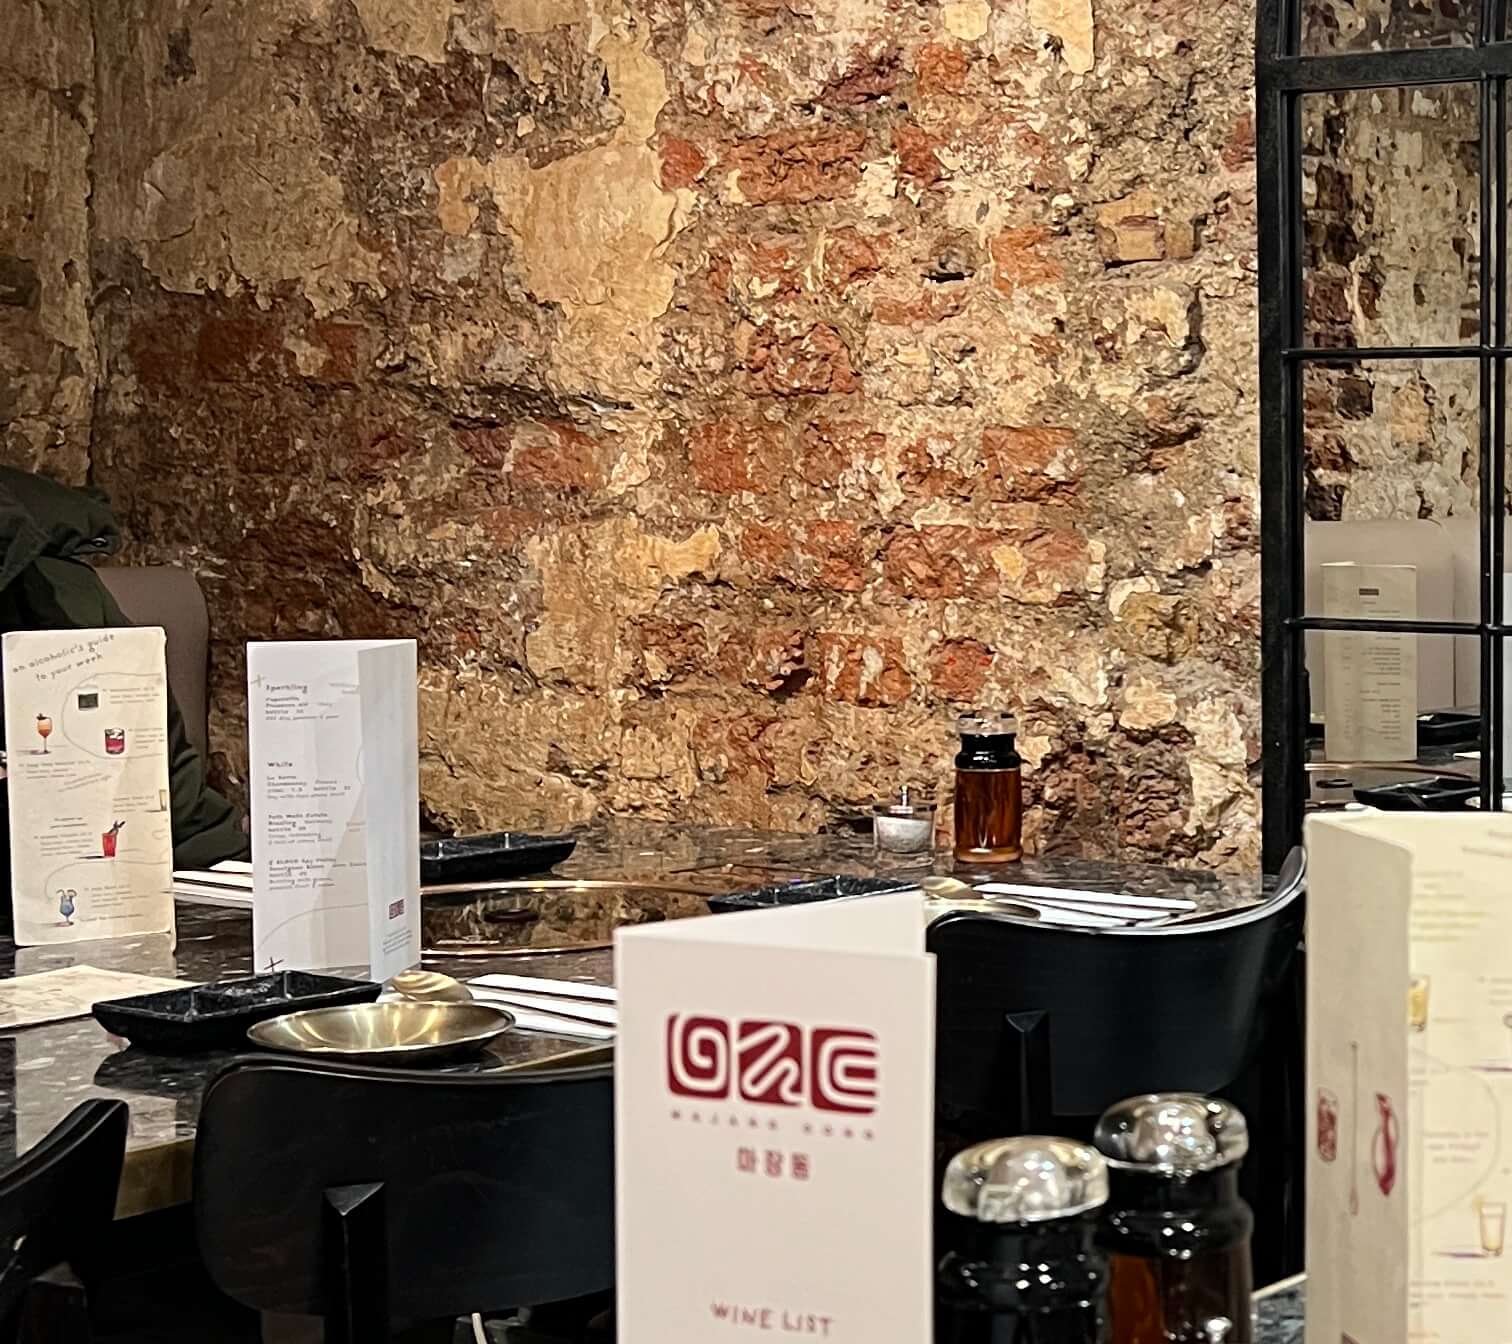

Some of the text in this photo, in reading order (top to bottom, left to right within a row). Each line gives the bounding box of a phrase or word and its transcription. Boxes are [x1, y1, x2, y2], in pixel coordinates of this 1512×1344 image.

[28, 643, 84, 667] alcoholic's
[87, 633, 115, 653] guide
[50, 663, 72, 680] your
[710, 1299, 834, 1338] WINE LIST
